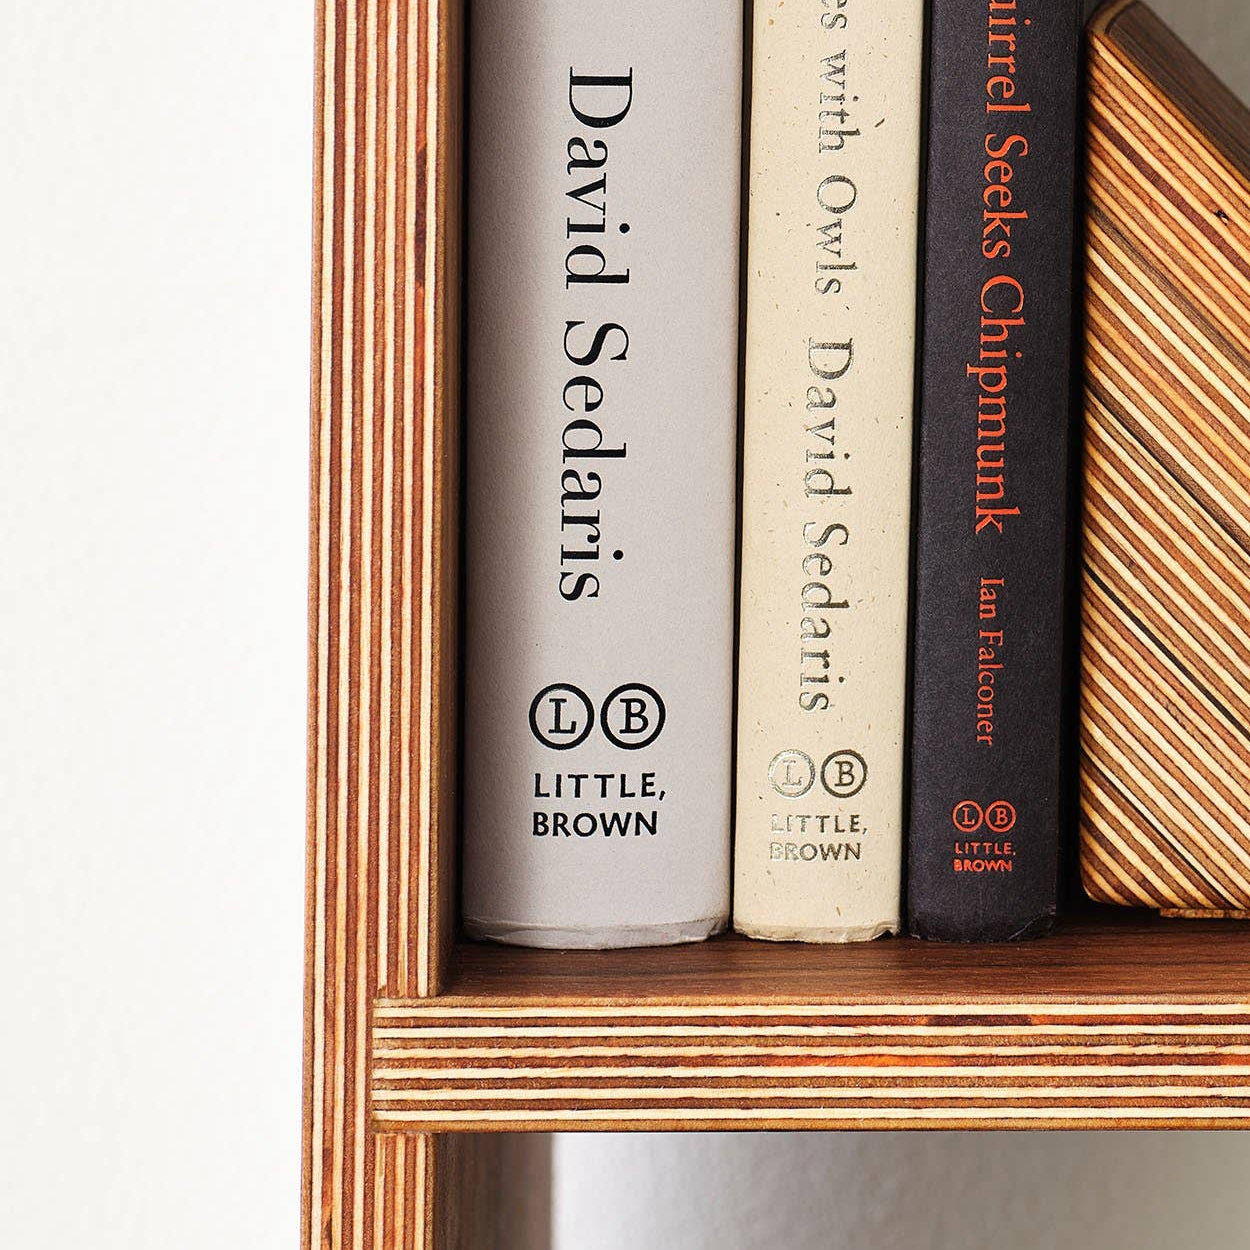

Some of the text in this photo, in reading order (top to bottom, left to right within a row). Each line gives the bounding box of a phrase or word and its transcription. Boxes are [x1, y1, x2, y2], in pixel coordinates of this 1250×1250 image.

[818, 48, 863, 154] with
[813, 175, 858, 295] Owls
[982, 133, 1028, 259] Seeks
[559, 67, 632, 600] David Sedaris
[965, 275, 1025, 533] Chipmunk
[798, 337, 855, 712] David Sedaris
[976, 578, 1004, 745] Ian Falconer
[533, 811, 657, 837] BROWN
[535, 773, 665, 800] LITTLE,
[771, 813, 868, 835] LITTLE,
[769, 841, 861, 862] BROWN
[953, 859, 1012, 872] BROWN
[955, 841, 1016, 856] LITTLE,
